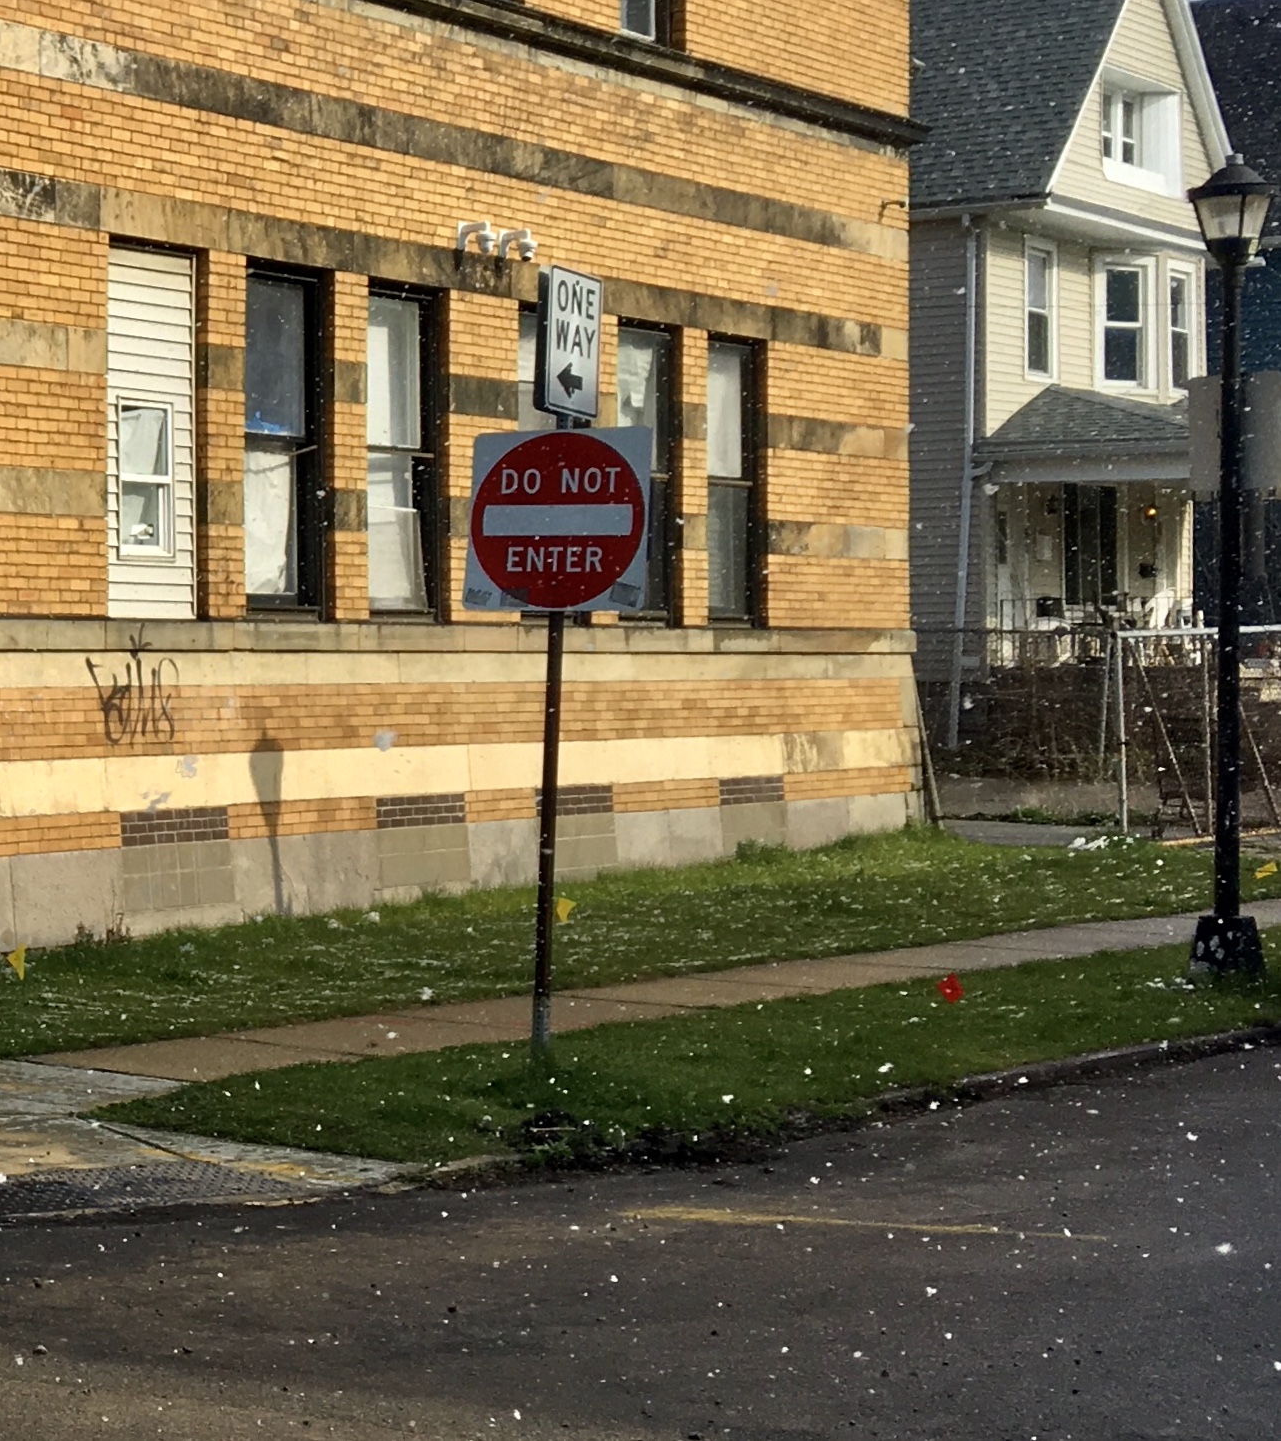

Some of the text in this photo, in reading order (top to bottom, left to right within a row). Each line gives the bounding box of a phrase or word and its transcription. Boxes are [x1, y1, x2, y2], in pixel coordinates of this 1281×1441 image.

[557, 279, 596, 320] ONE
[556, 318, 596, 359] WAY
[501, 467, 621, 495] DO NOT
[506, 546, 603, 573] ENTER
